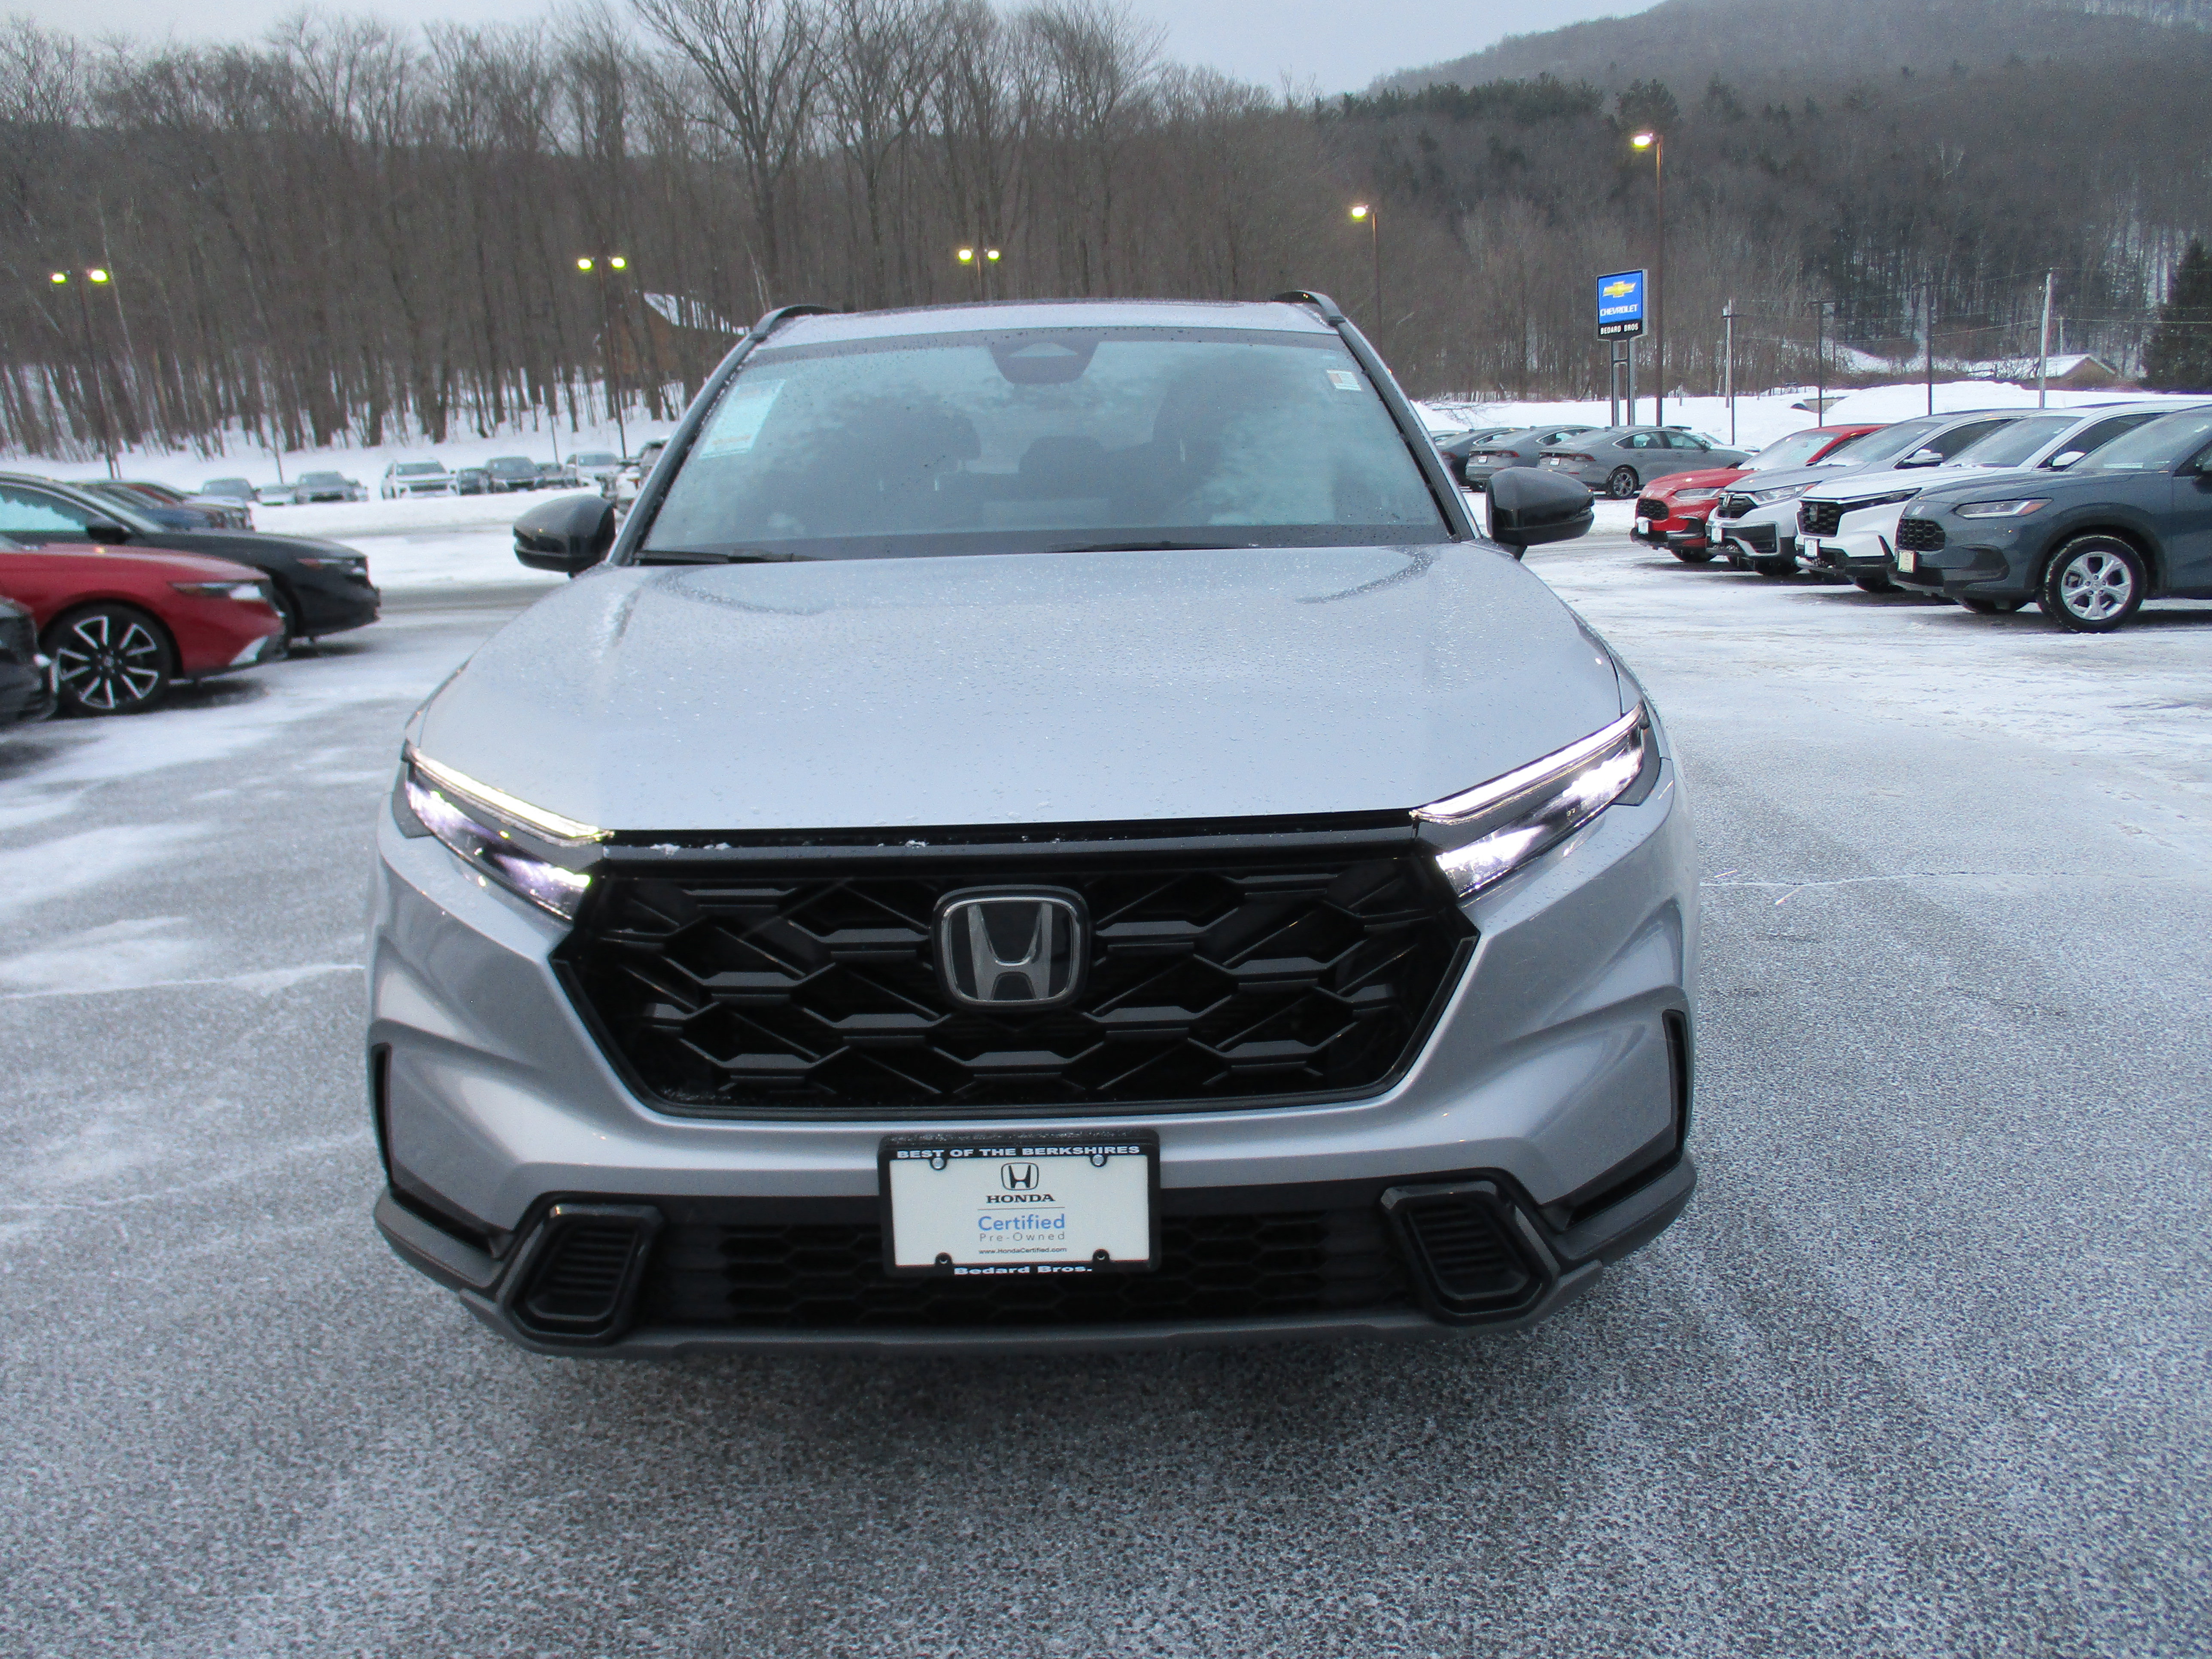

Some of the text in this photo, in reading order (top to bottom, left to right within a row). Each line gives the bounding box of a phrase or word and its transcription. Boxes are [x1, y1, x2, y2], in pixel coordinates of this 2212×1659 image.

[1599, 304, 1638, 316] CHEVROLET
[1600, 323, 1638, 335] BEDARD BROS
[897, 1146, 1140, 1158] BEST OF THE BERKSHIRES
[986, 1194, 1055, 1203] HONDA
[978, 1213, 1065, 1231] Certified
[979, 1231, 1065, 1242] Pre-Owned
[954, 1265, 1093, 1275] Bedard Bros.
